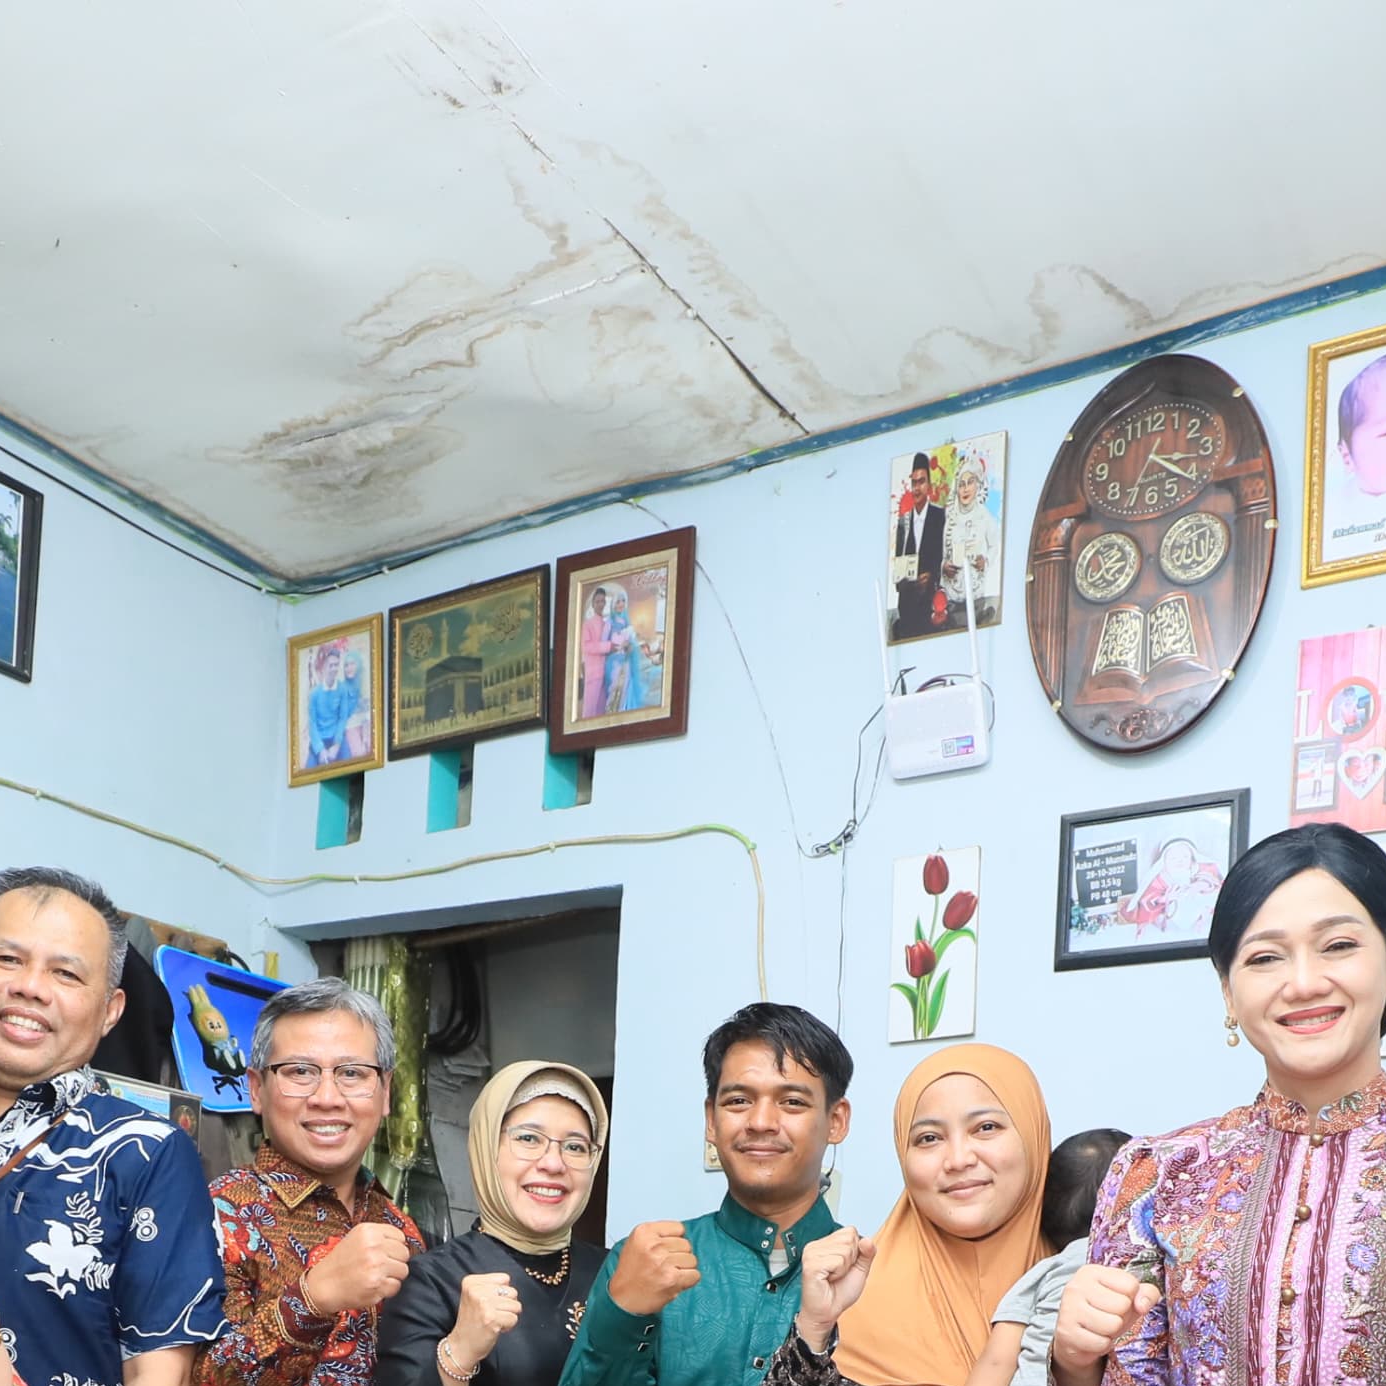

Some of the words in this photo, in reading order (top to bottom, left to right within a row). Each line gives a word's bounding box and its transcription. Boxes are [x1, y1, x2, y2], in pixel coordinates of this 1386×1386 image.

[1125, 419, 1142, 441] 11
[1145, 412, 1165, 433] 12
[1172, 410, 1179, 430] 1
[1186, 418, 1201, 440] 2
[1108, 438, 1126, 458] 10
[1198, 436, 1213, 456] 3
[1095, 463, 1109, 482] 9
[1186, 462, 1198, 481] 4
[1107, 481, 1120, 500] 8
[1126, 487, 1139, 507] 7
[1144, 486, 1159, 505] 6
[1164, 477, 1179, 498] 5
[1086, 842, 1125, 858] Muhammad
[1112, 877, 1122, 887] kg
[1111, 889, 1122, 897] cm
